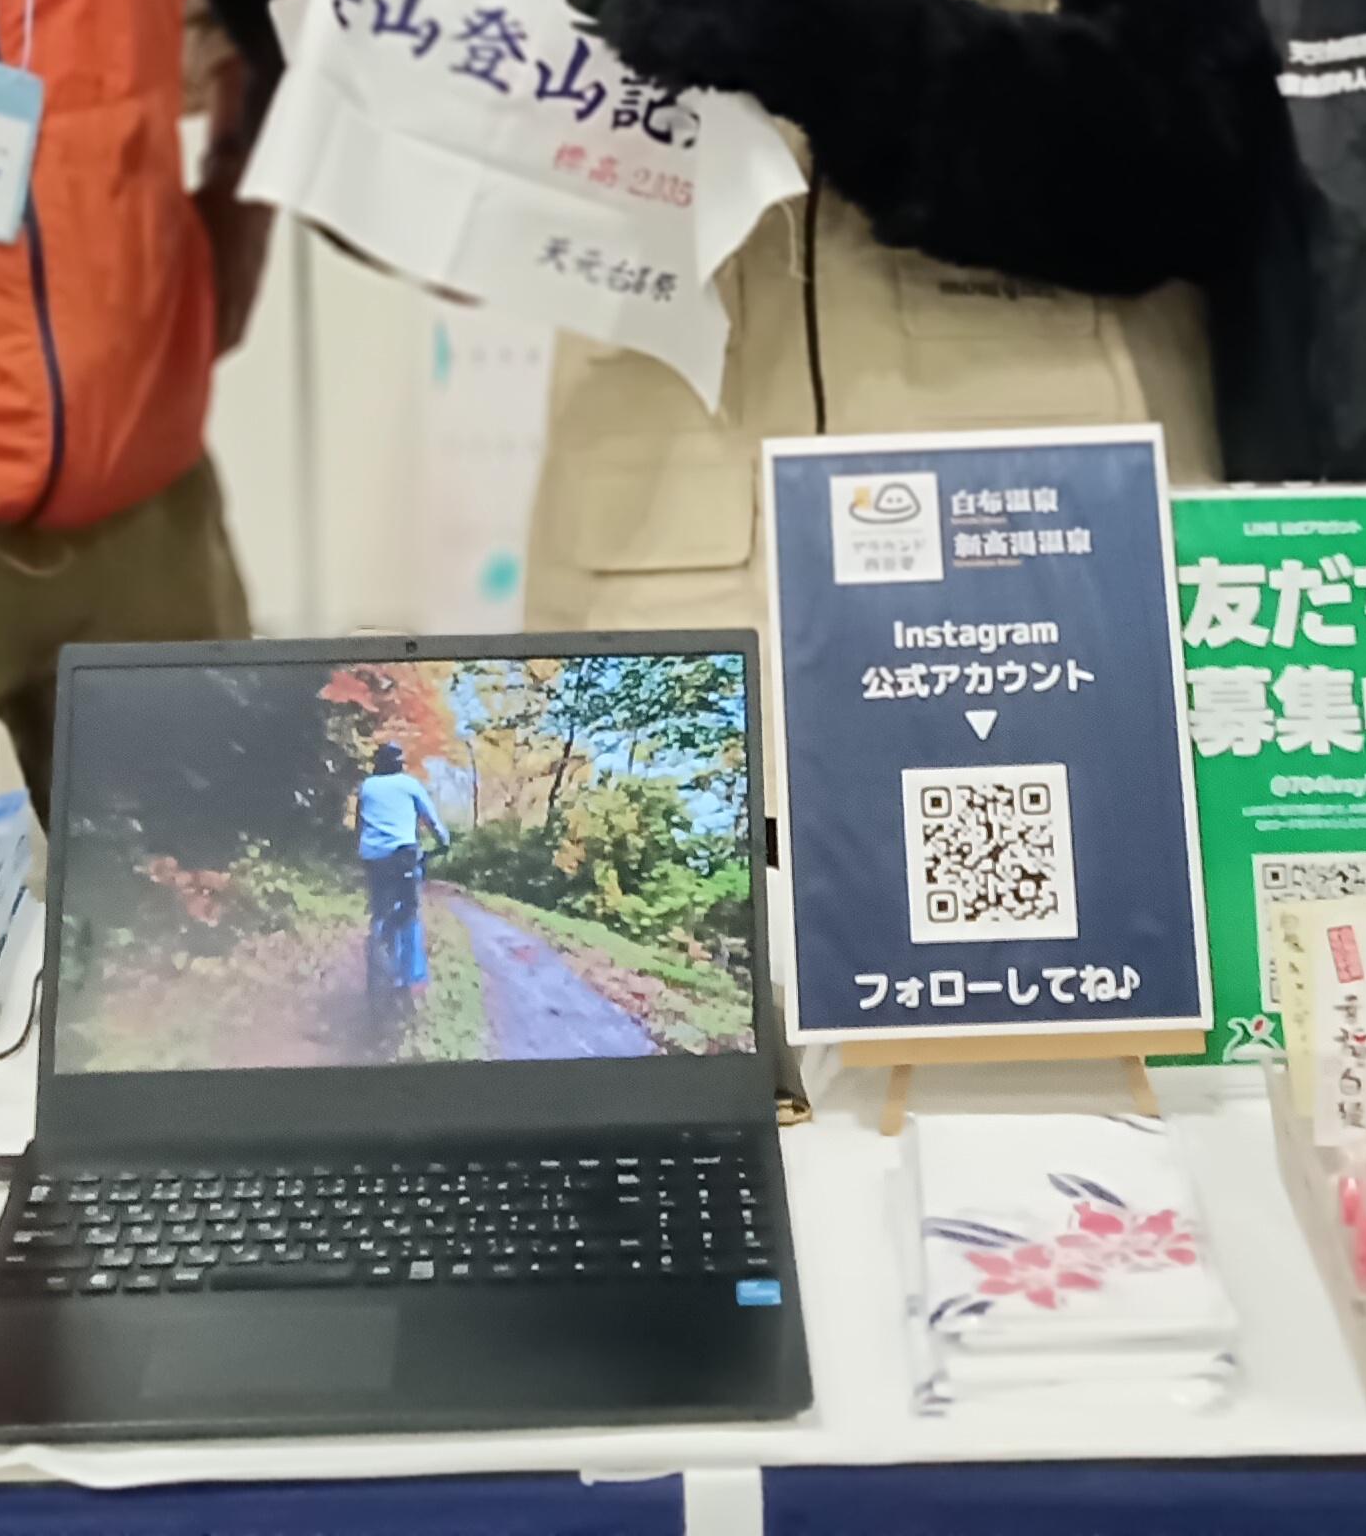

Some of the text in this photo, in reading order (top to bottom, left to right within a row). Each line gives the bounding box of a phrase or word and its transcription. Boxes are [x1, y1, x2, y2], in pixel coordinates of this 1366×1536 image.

[893, 620, 1059, 653] Instagram
[861, 659, 1095, 699] 公式アカウント
